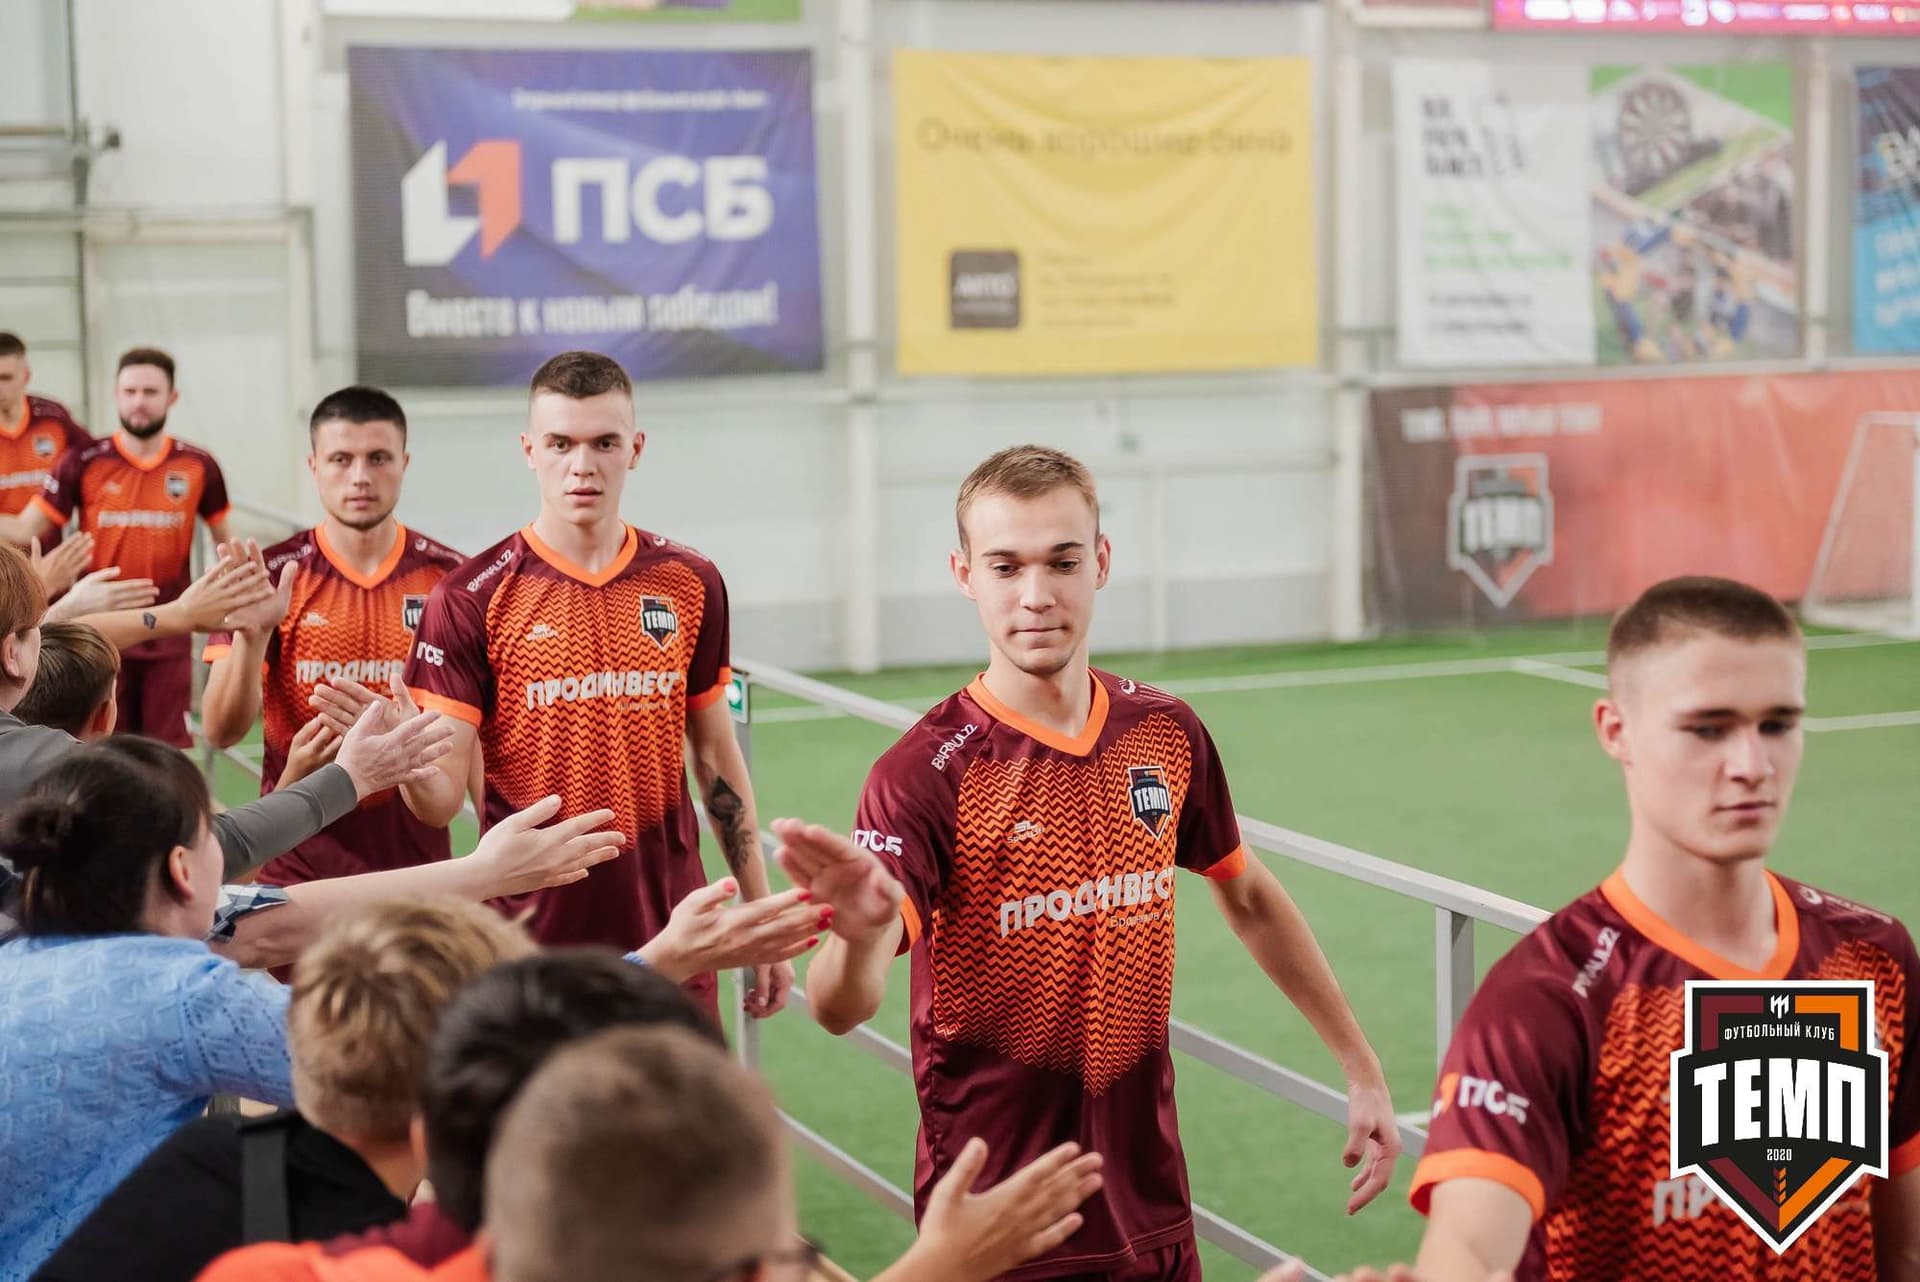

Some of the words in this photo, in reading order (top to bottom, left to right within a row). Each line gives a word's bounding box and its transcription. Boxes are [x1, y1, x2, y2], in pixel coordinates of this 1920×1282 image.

[551, 155, 774, 244] ПСБ
[644, 610, 676, 631] ТЕМП
[527, 670, 680, 711] ПРОДИНВЕСТ
[1134, 786, 1169, 813] ТЕМП
